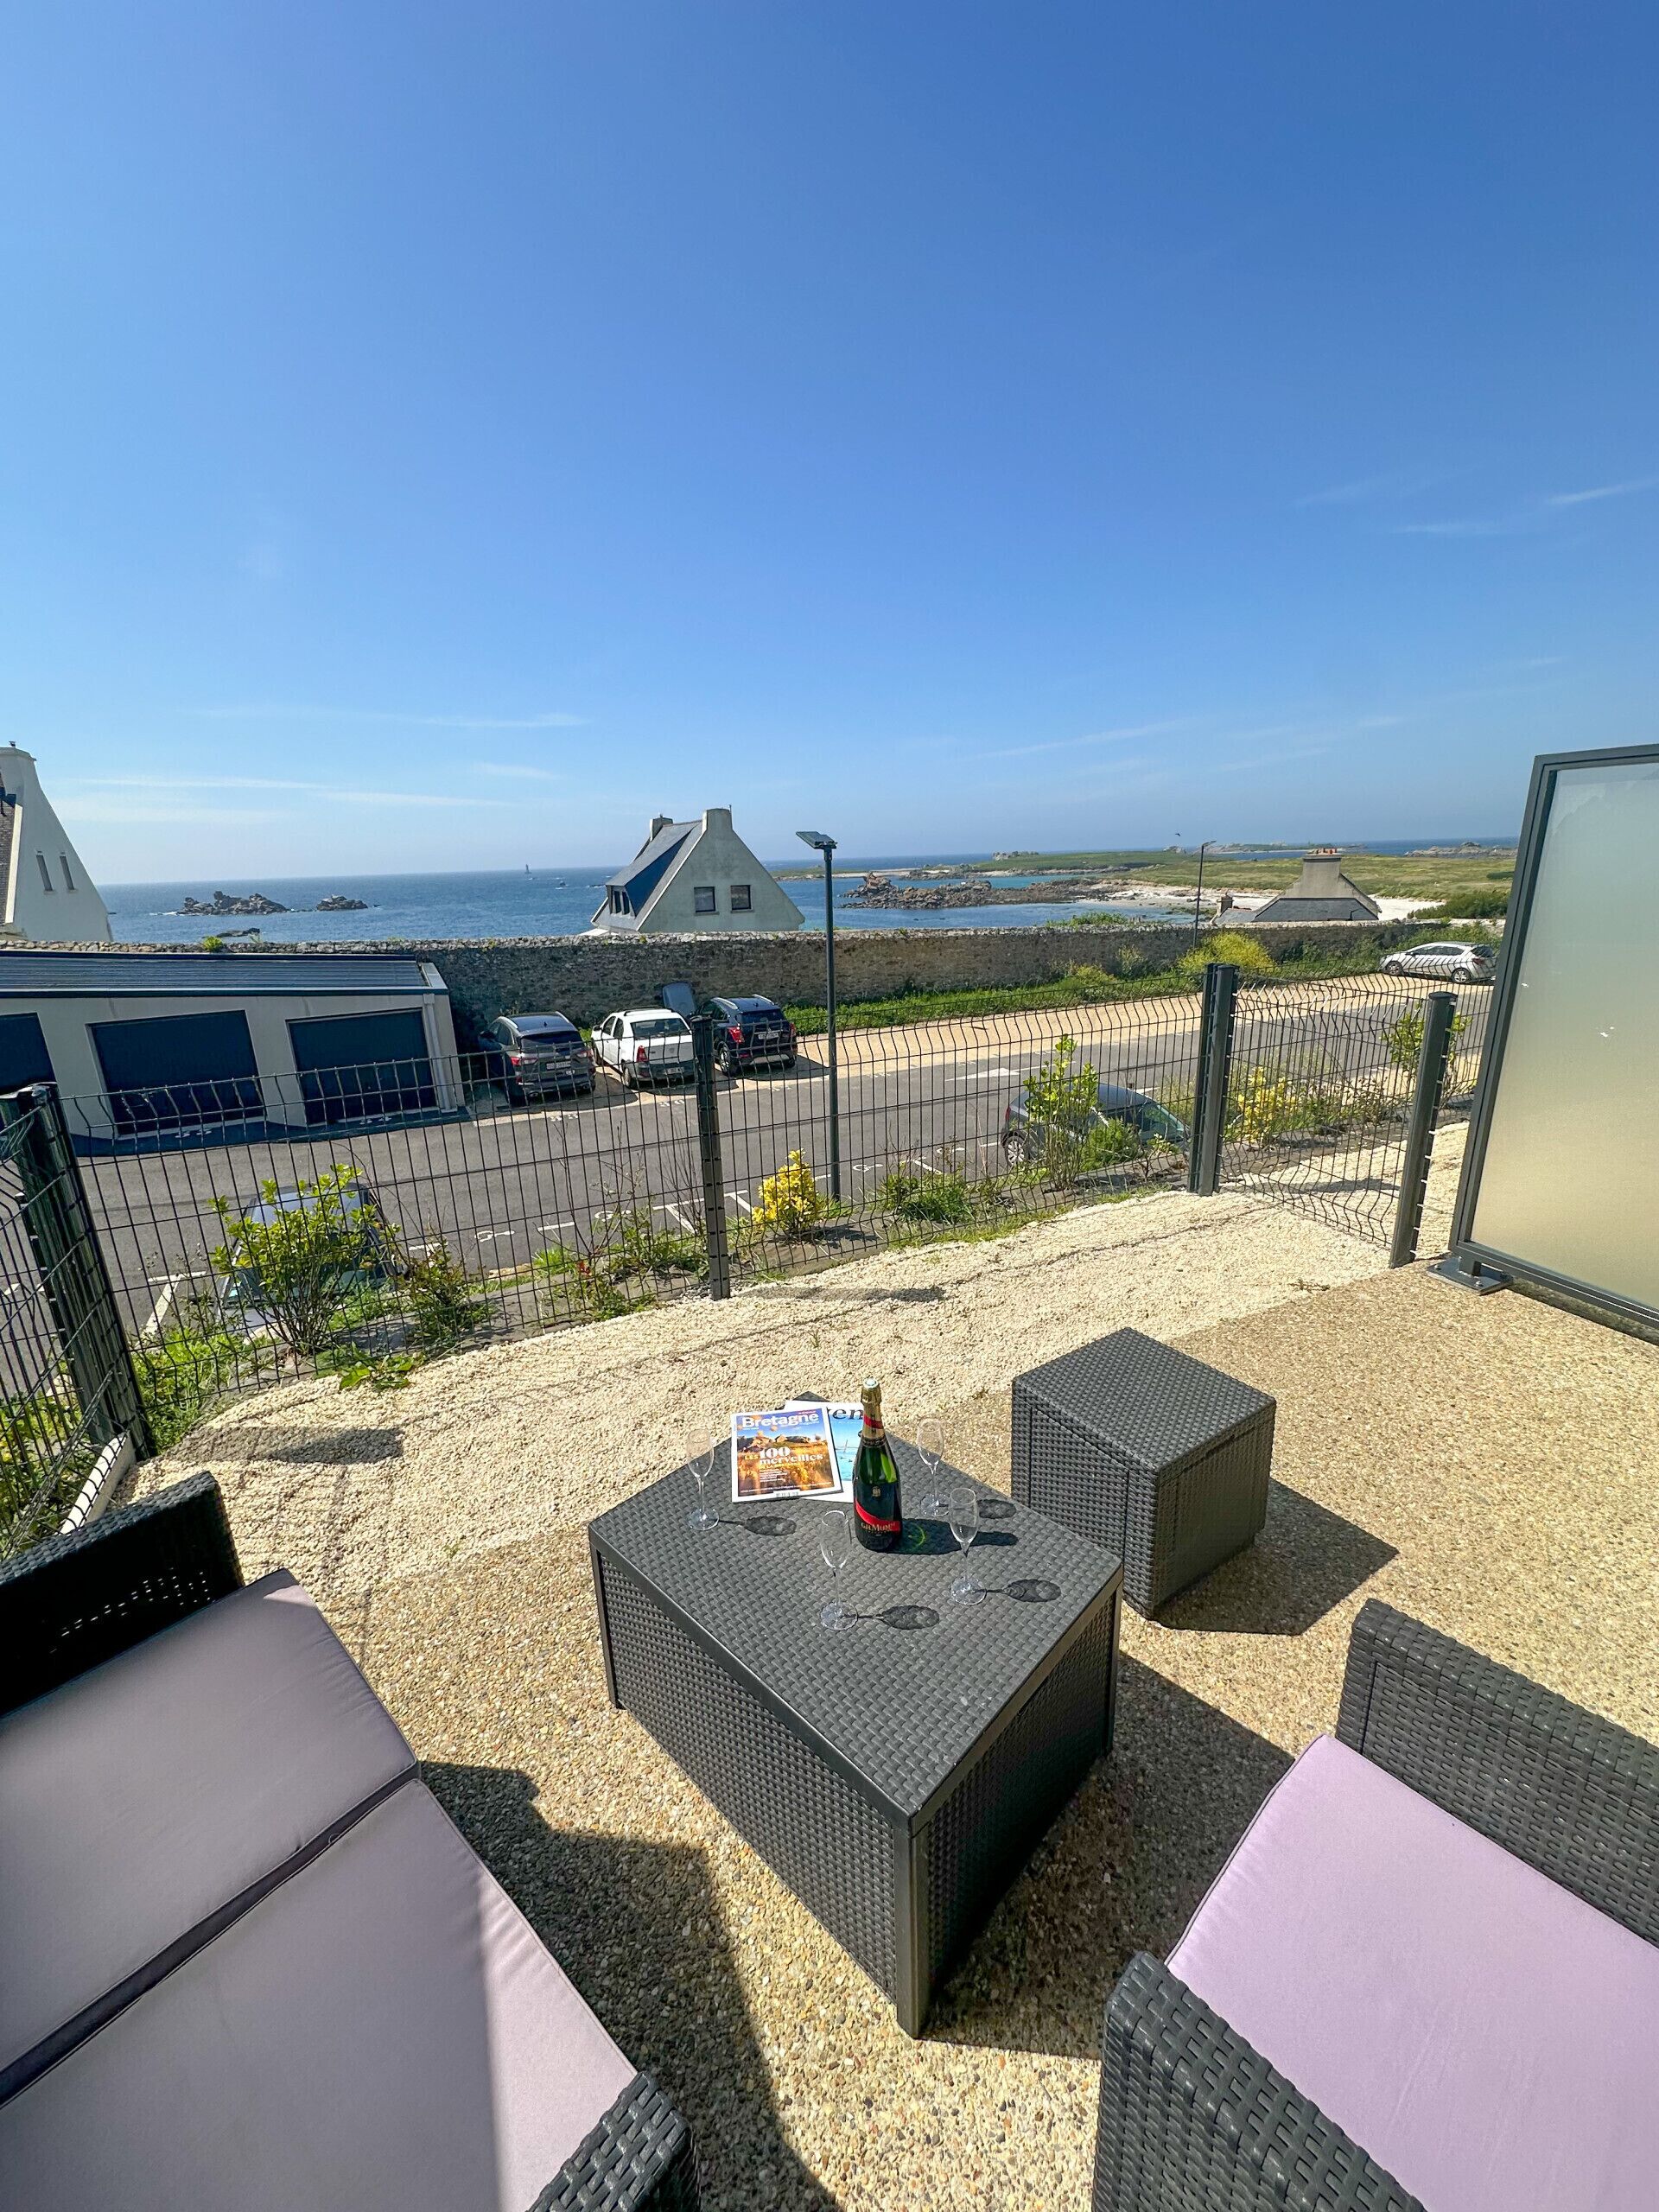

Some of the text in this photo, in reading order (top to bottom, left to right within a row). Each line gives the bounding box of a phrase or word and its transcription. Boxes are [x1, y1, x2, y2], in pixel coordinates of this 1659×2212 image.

[742, 1412, 820, 1427] Bretagne
[828, 1408, 864, 1420] en
[760, 1446, 791, 1459] 100
[760, 1453, 823, 1465] merveilles
